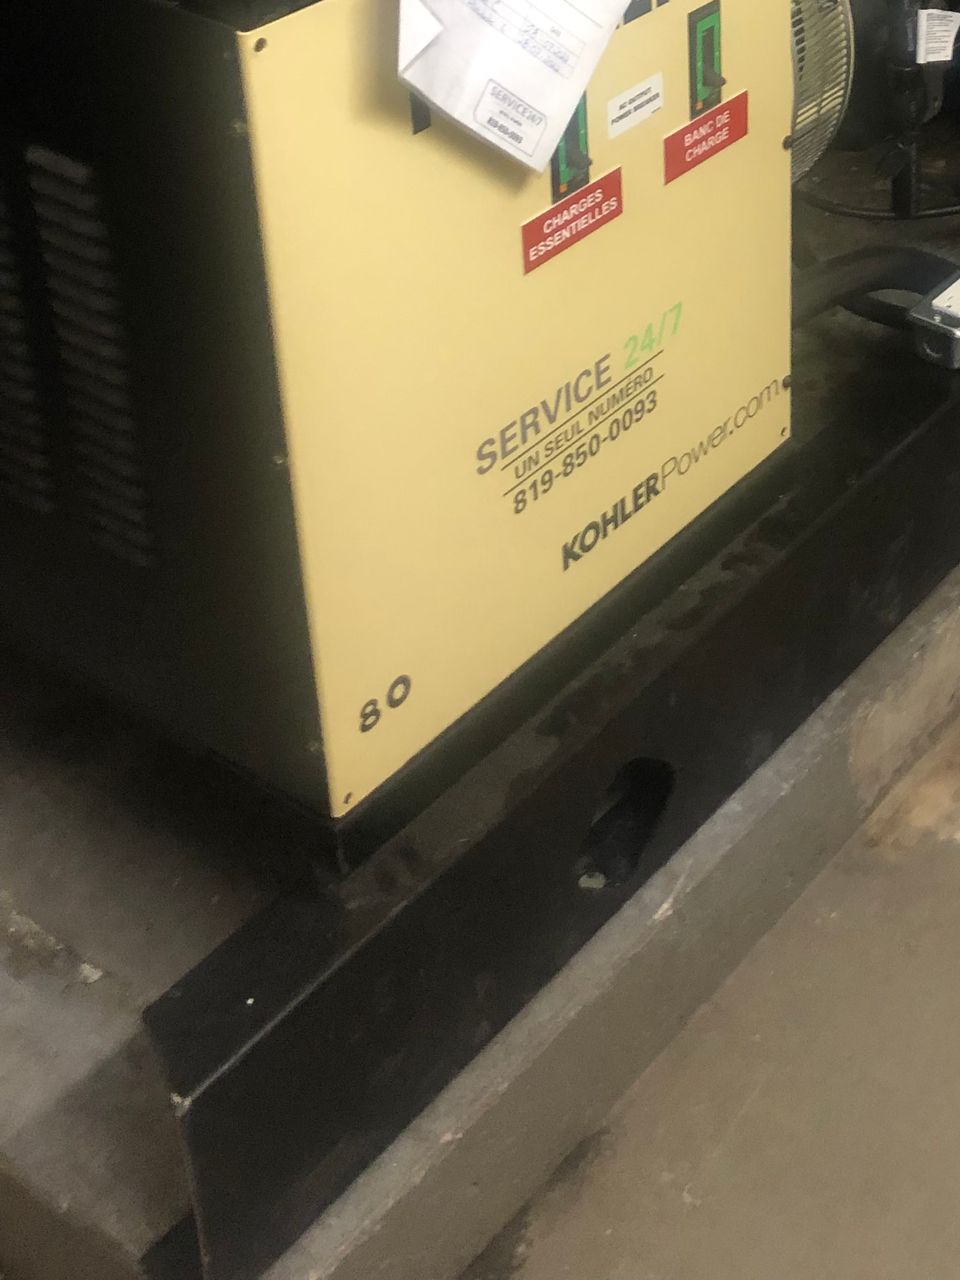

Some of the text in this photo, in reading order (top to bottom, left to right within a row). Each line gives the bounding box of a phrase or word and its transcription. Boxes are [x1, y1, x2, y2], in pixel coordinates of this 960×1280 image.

[684, 110, 731, 147] BANC DE
[685, 126, 730, 162] CHARGE
[529, 196, 618, 262] ESSENTIELLES
[543, 188, 604, 234] CHARGES
[476, 300, 683, 476] SERVICE 24/7
[513, 366, 654, 481] UN SEUL NUMÉRO
[513, 389, 658, 515] 819-850-0093
[562, 378, 780, 572] KOHLERPower.com
